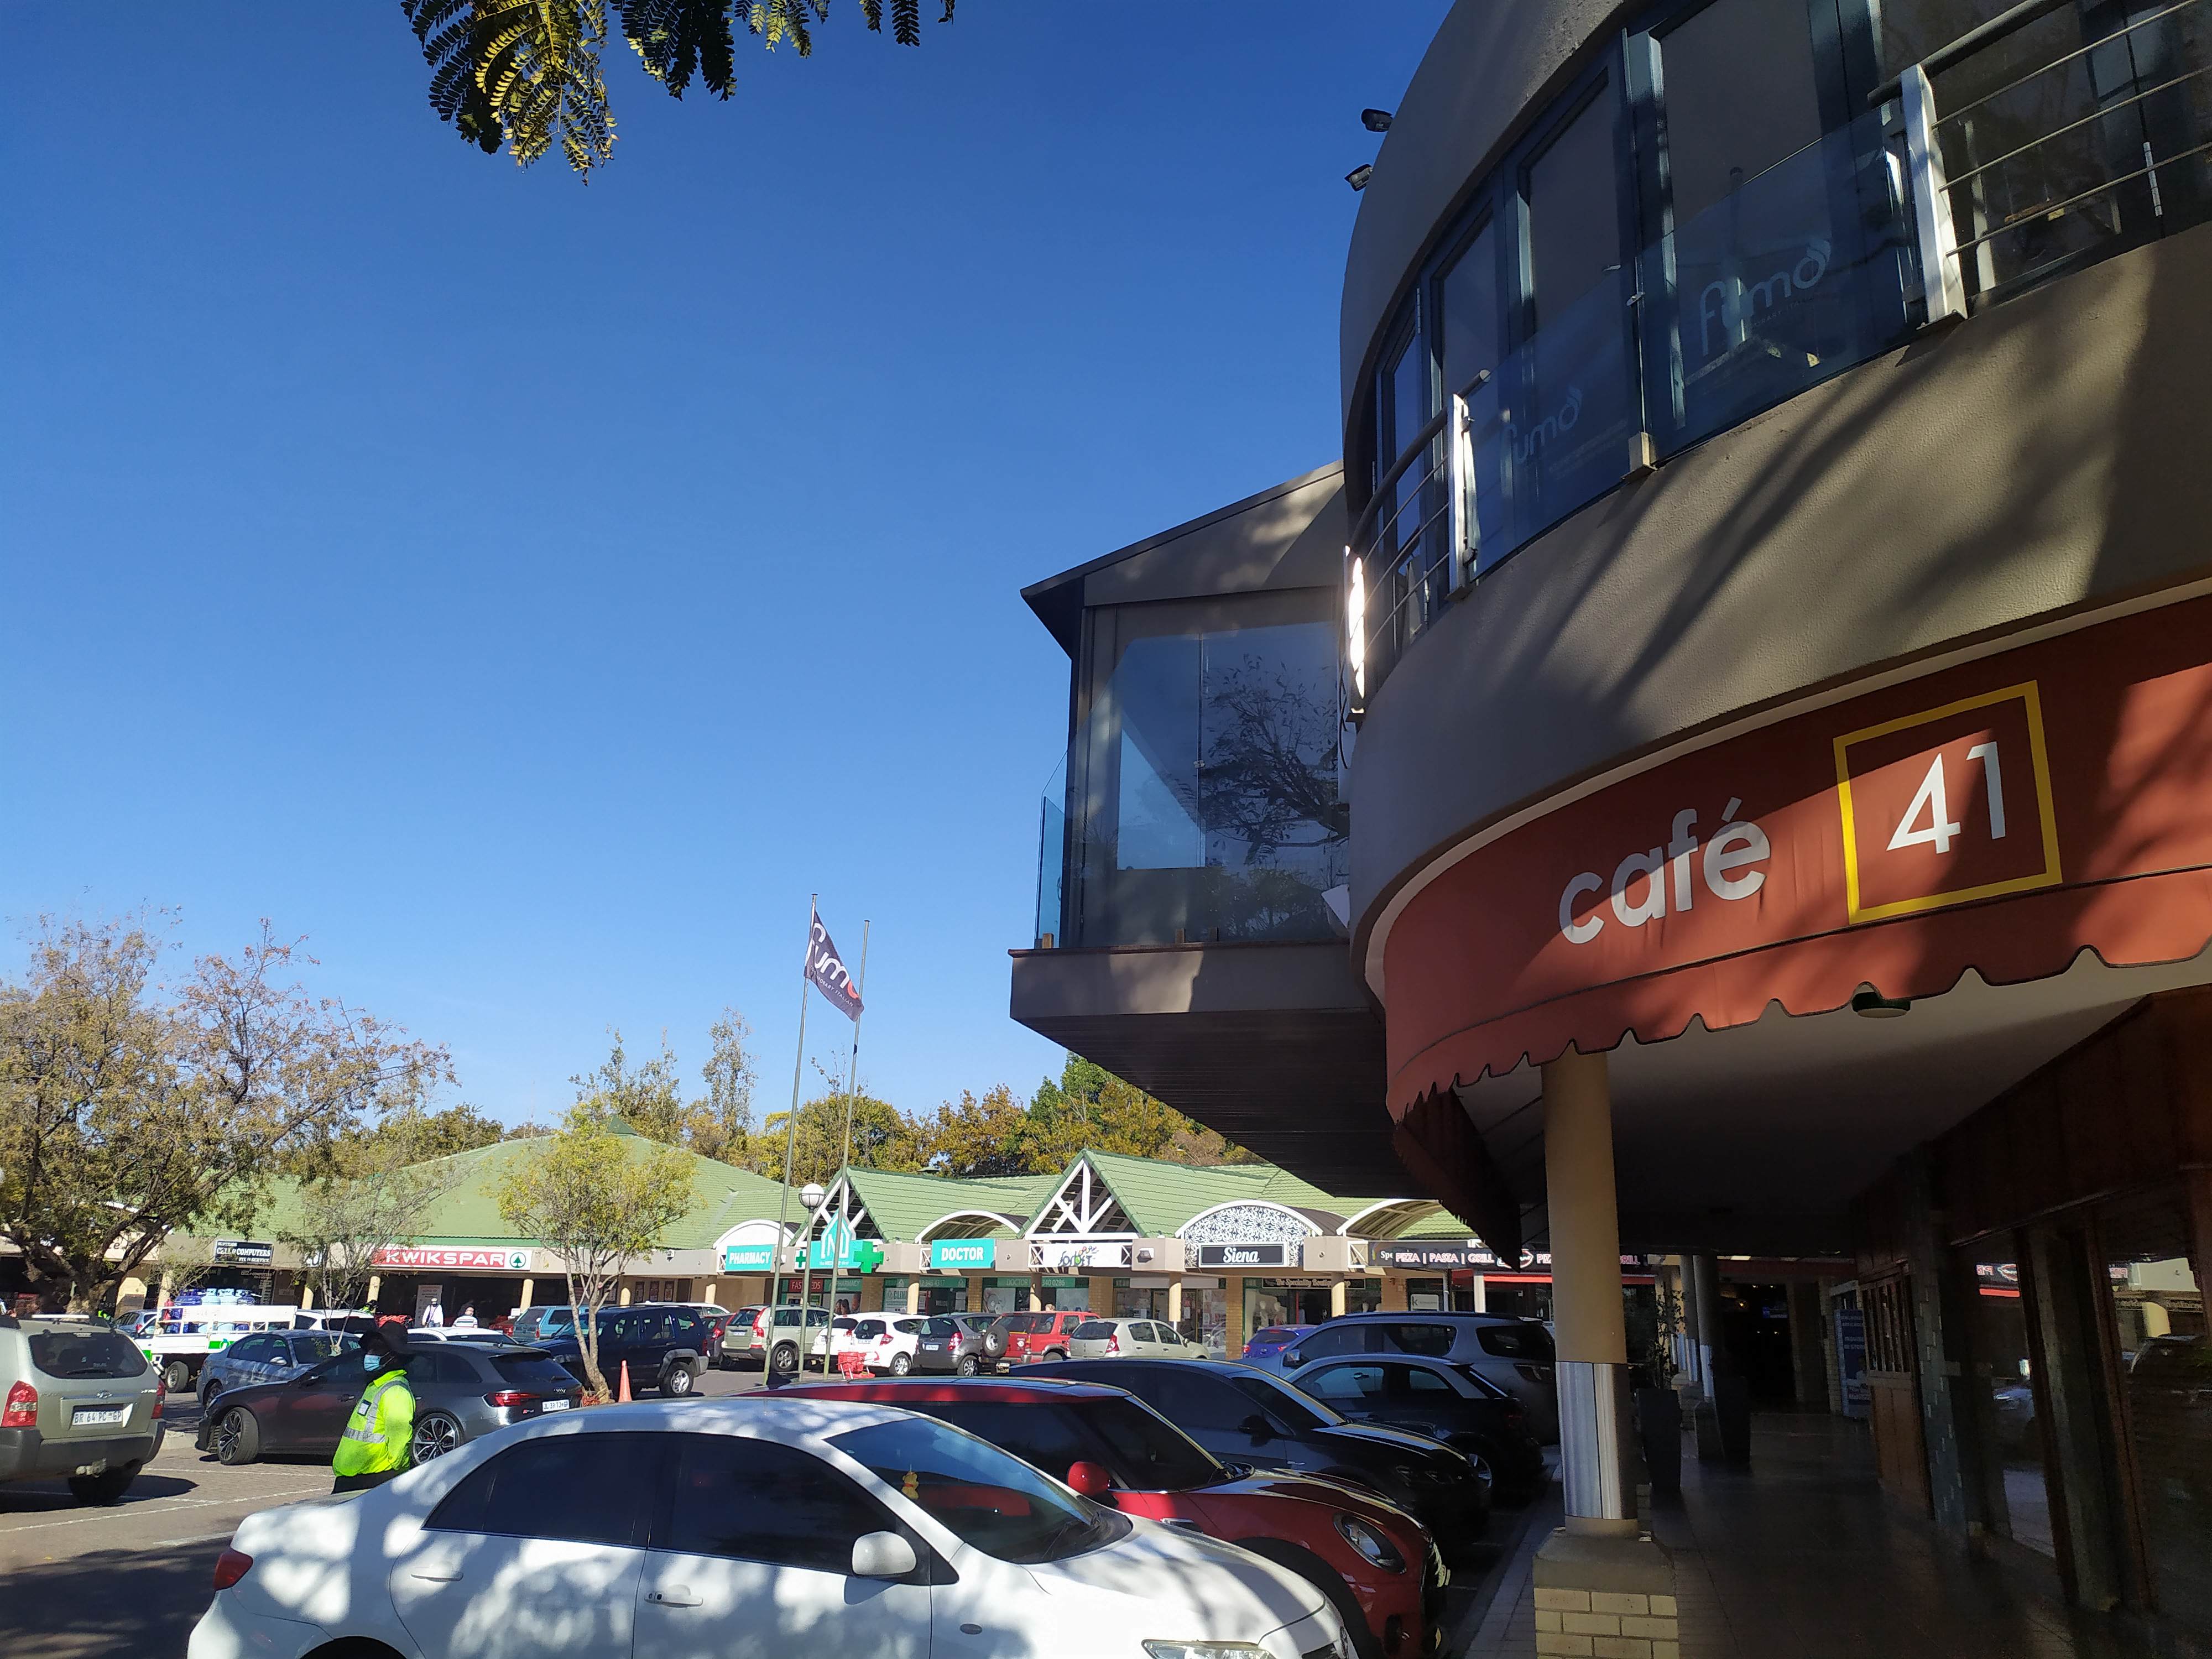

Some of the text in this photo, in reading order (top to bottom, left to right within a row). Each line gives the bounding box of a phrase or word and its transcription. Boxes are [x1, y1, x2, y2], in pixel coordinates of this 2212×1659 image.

[1559, 741, 2006, 944] café 41
[236, 1248, 271, 1257] COMPUTERS
[385, 1250, 504, 1266] KWIKSPAR
[729, 1251, 771, 1265] PHARMACY
[941, 1246, 984, 1261] DOCTOR
[1223, 1246, 1260, 1264] Siena
[1429, 1253, 1459, 1263] PASTA
[1467, 1253, 1495, 1264] GRILL
[1536, 1254, 1552, 1264] PIZ
[791, 1281, 802, 1290] FAS
[1312, 1278, 1332, 1288] Boutiq
[74, 1413, 84, 1423] BR
[86, 1413, 96, 1422] 64
[112, 1411, 122, 1421] GP
